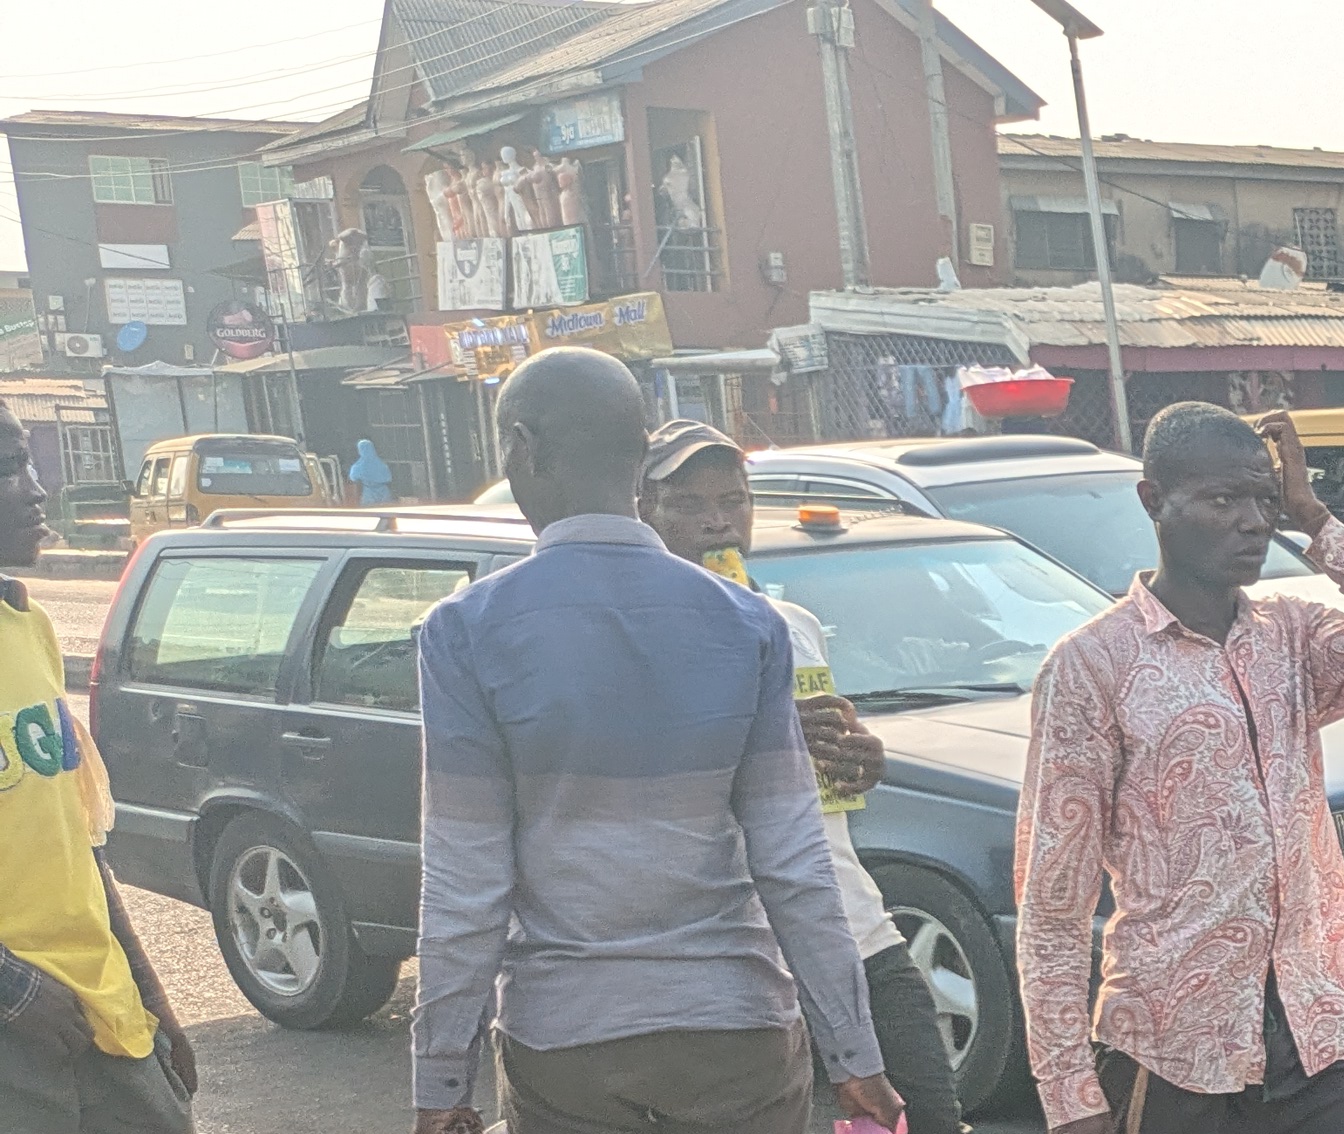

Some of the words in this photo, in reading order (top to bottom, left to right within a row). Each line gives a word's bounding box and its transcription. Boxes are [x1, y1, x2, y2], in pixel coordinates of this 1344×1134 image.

[550, 311, 604, 337] Midtown
[617, 300, 646, 326] Mall
[216, 327, 267, 338] GOLDBERG
